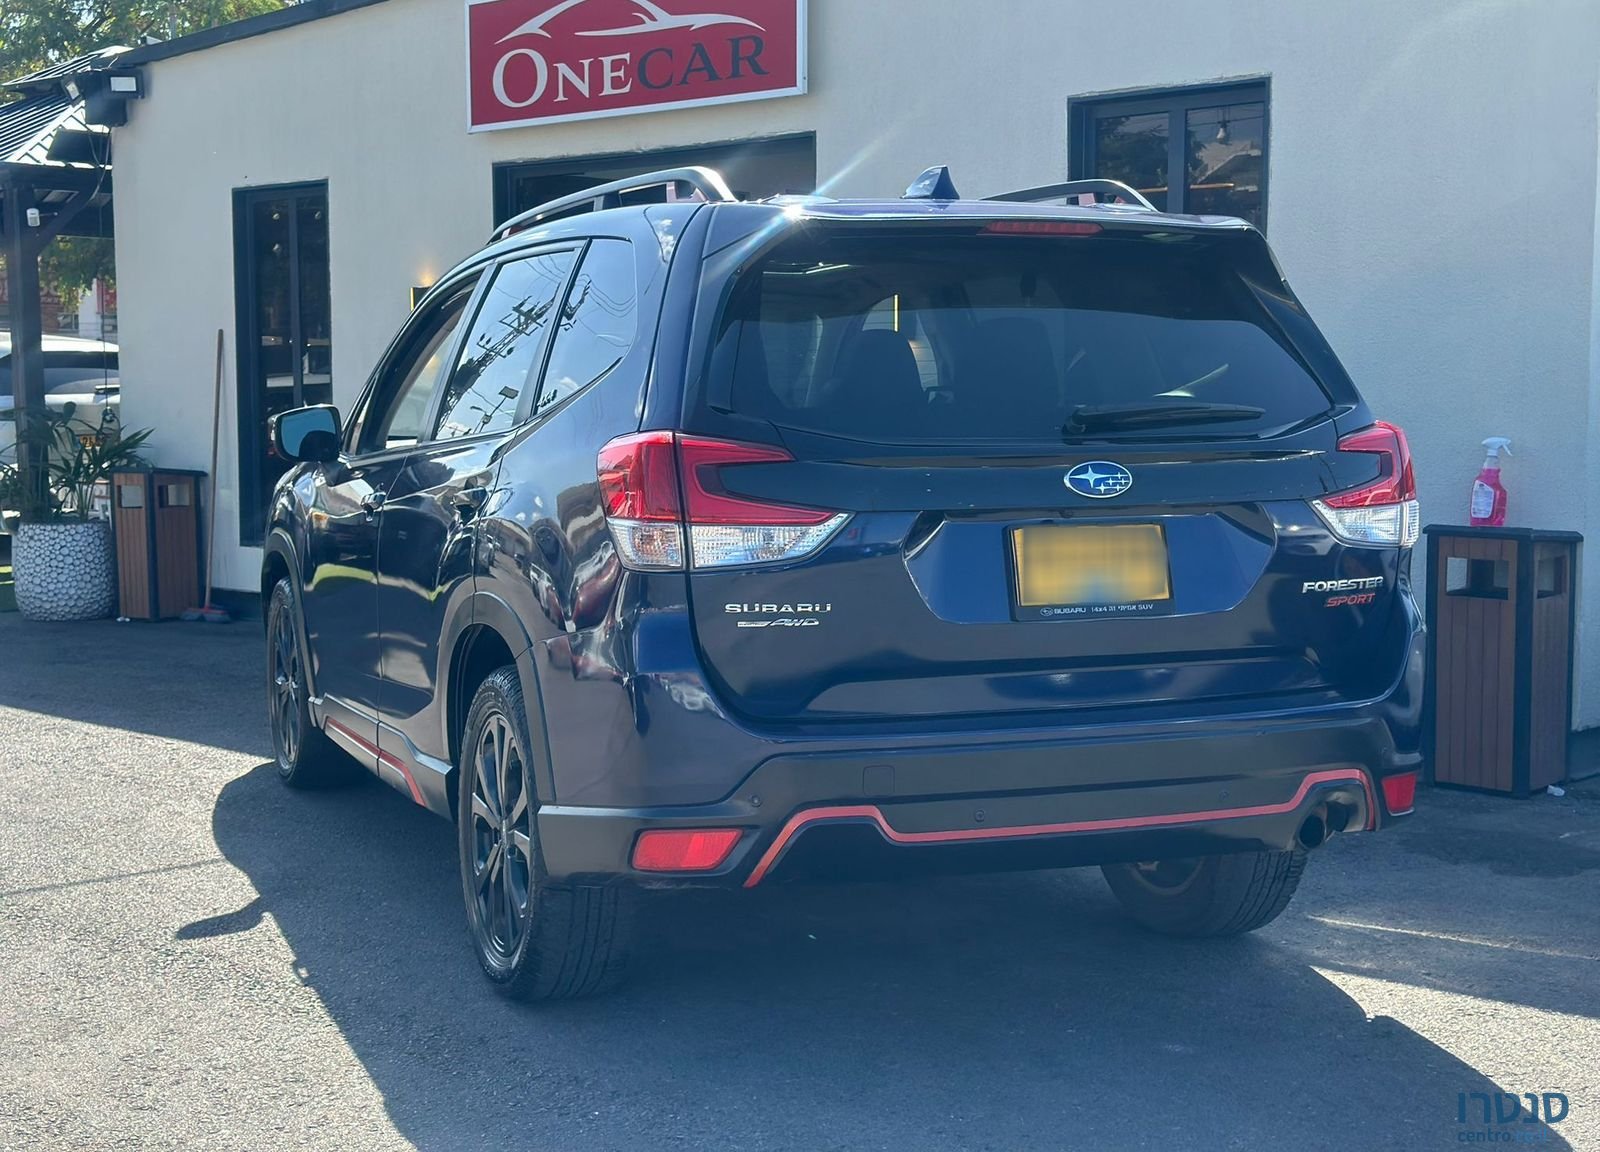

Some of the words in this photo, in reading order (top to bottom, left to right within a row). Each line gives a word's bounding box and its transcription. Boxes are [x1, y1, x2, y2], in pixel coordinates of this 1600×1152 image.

[1302, 576, 1384, 593] FORESTER
[1325, 593, 1376, 608] SPORT
[724, 603, 831, 614] SUBARU
[770, 618, 819, 627] AWD
